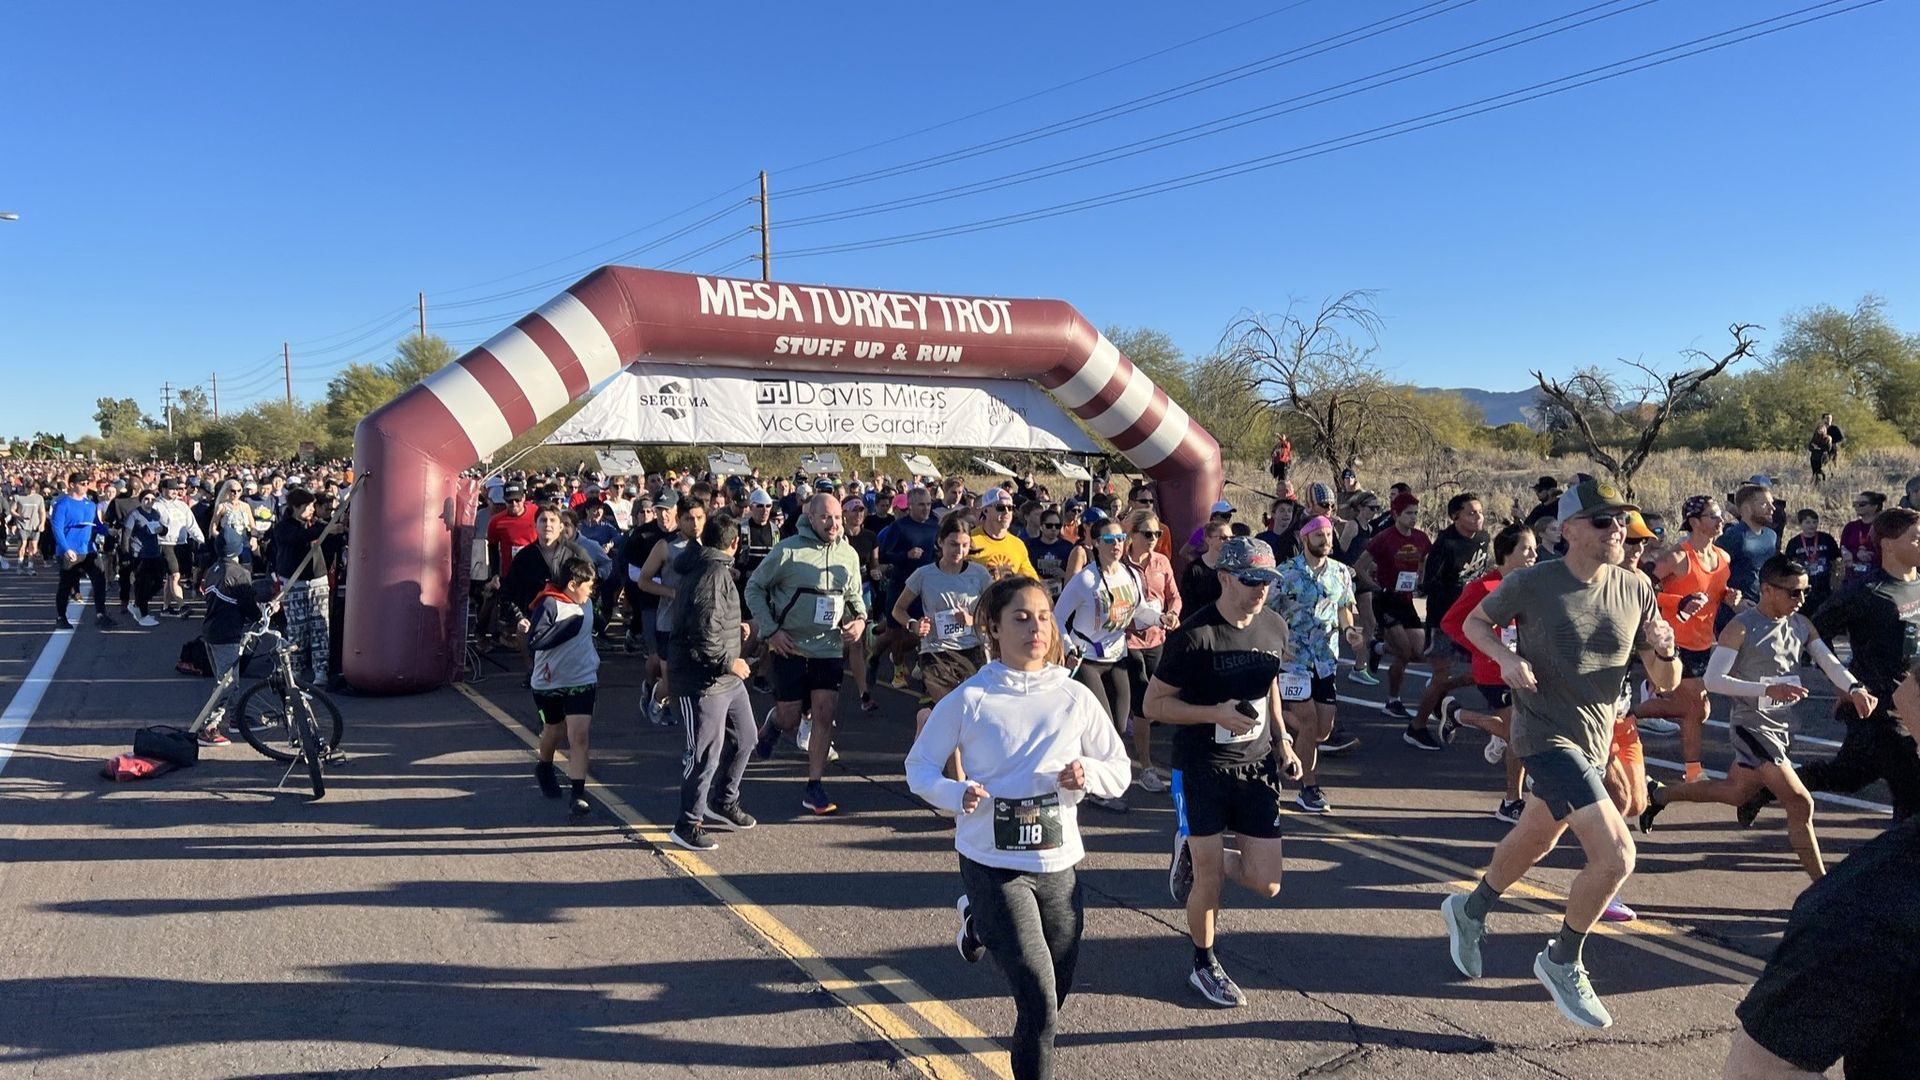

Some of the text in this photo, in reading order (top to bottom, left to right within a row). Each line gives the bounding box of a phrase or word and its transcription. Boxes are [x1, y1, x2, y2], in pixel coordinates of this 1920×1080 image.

[696, 277, 1012, 335] MESA TURKEY TROT
[774, 336, 963, 363] STUFF UP & RUN
[639, 395, 709, 407] SERTOMA
[795, 381, 947, 410] Davis Miles
[757, 413, 948, 435] McGuire Gardner
[1284, 686, 1303, 696] 1637
[1018, 824, 1043, 845] 118
